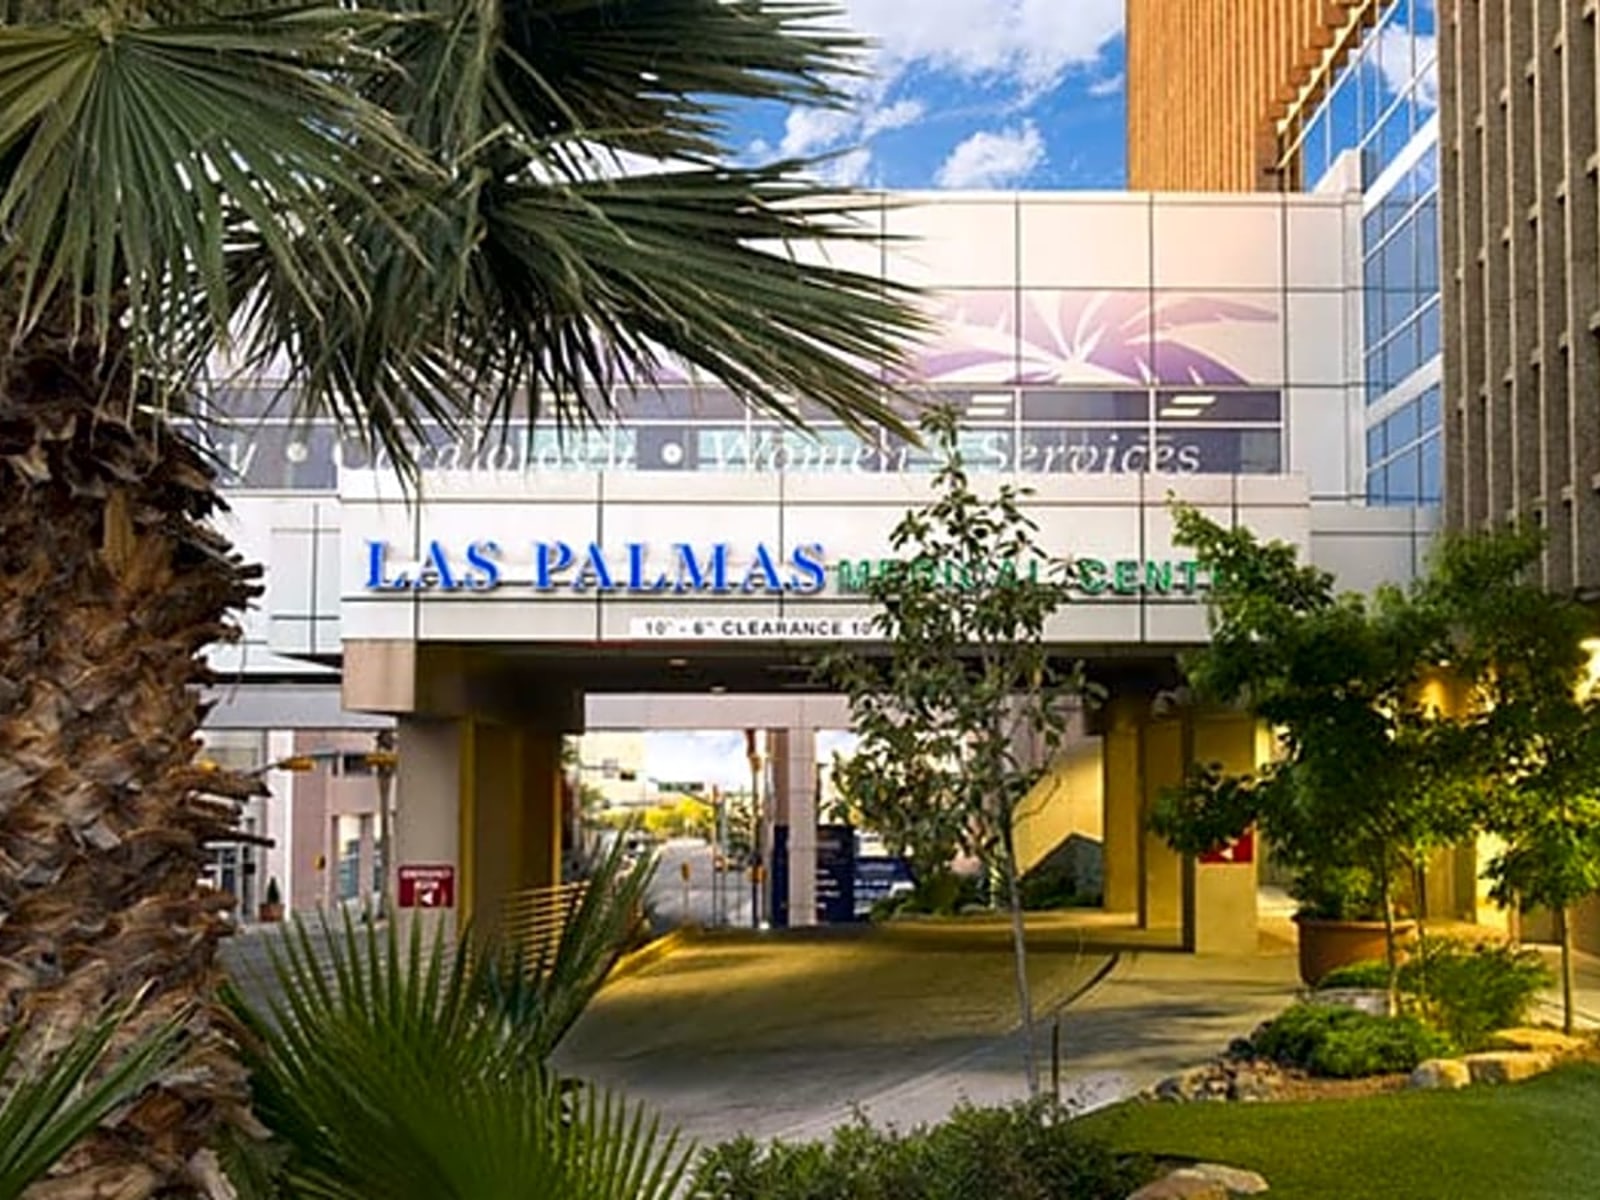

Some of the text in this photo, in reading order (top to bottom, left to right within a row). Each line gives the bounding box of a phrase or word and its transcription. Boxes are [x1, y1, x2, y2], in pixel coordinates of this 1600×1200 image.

[979, 431, 1201, 474] Services
[365, 540, 500, 590] LAS
[533, 540, 826, 592] PALMAS
[721, 620, 842, 636] CLEARANCE
